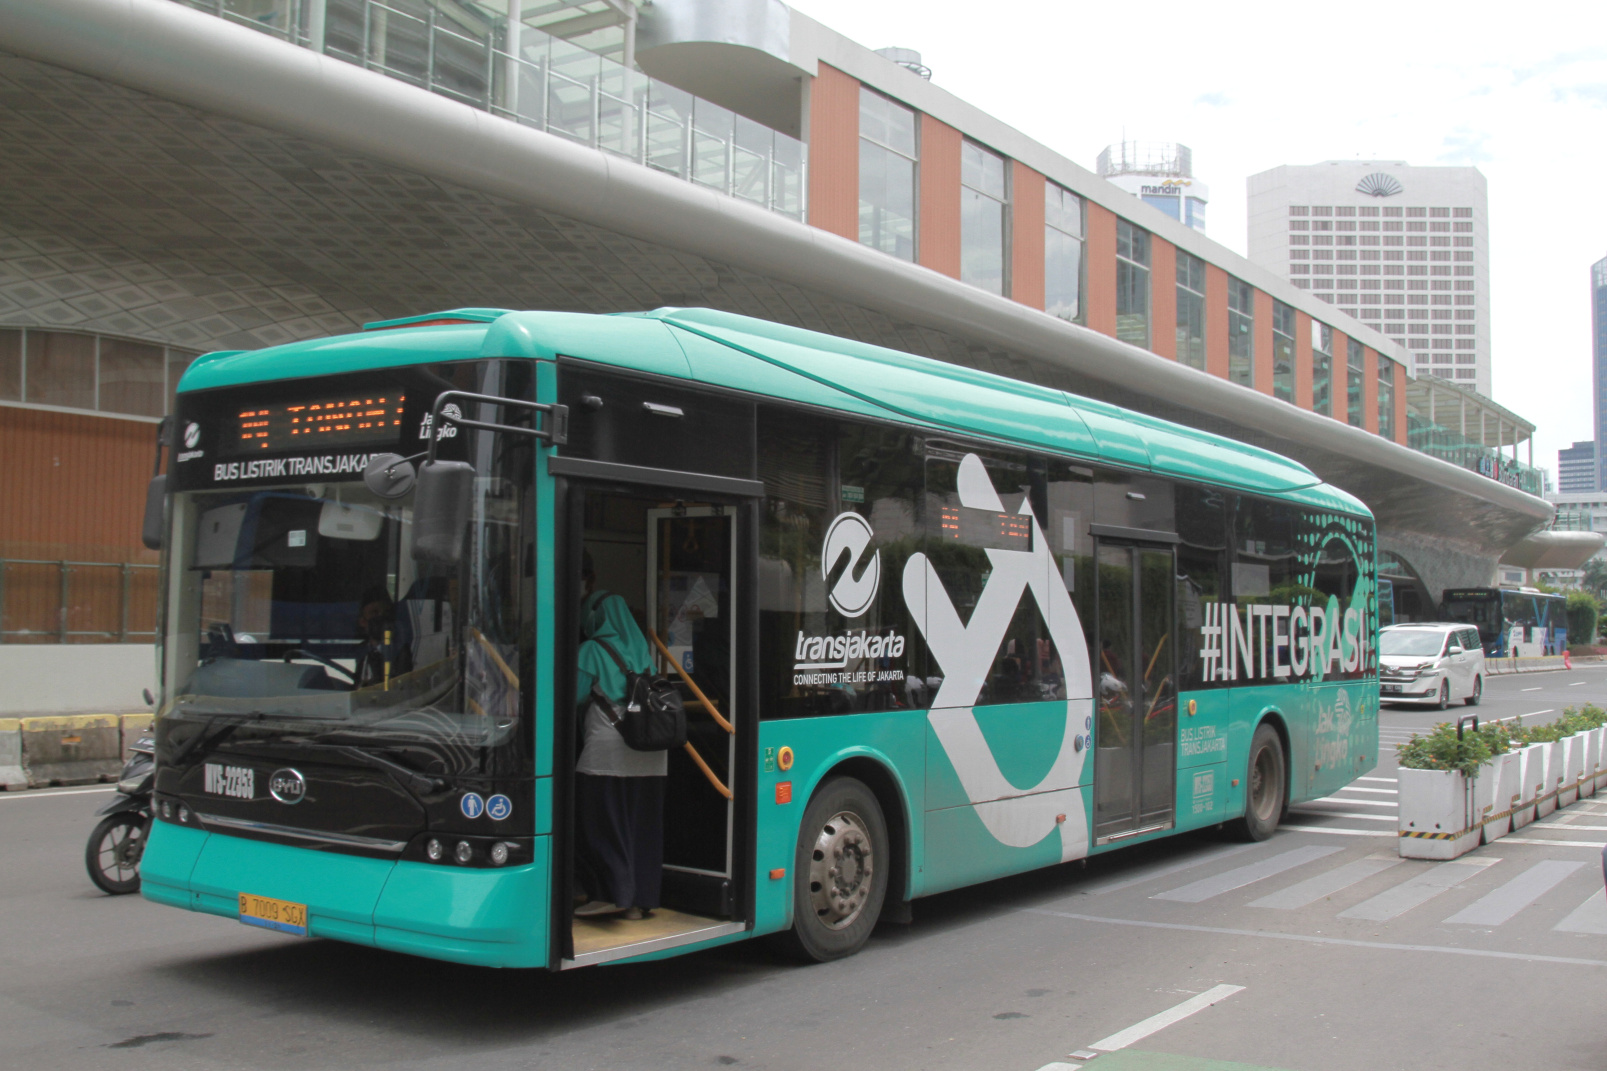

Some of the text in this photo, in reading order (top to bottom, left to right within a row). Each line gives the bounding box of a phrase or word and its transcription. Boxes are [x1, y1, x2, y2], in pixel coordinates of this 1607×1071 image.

[1141, 184, 1181, 195] mandiri
[214, 453, 379, 480] BUS LISTRIK TRANSJAKA
[793, 630, 905, 670] transjakarta
[1200, 602, 1365, 682] #INTEGRASI
[793, 670, 904, 685] CONNECTING THE LIFE OF JAKARTA
[1181, 725, 1216, 742] BUS LISTRIK
[1181, 737, 1226, 756] TRANSJAKARTA
[273, 778, 301, 794] BYD
[241, 896, 248, 913] B
[253, 898, 279, 920] 7009
